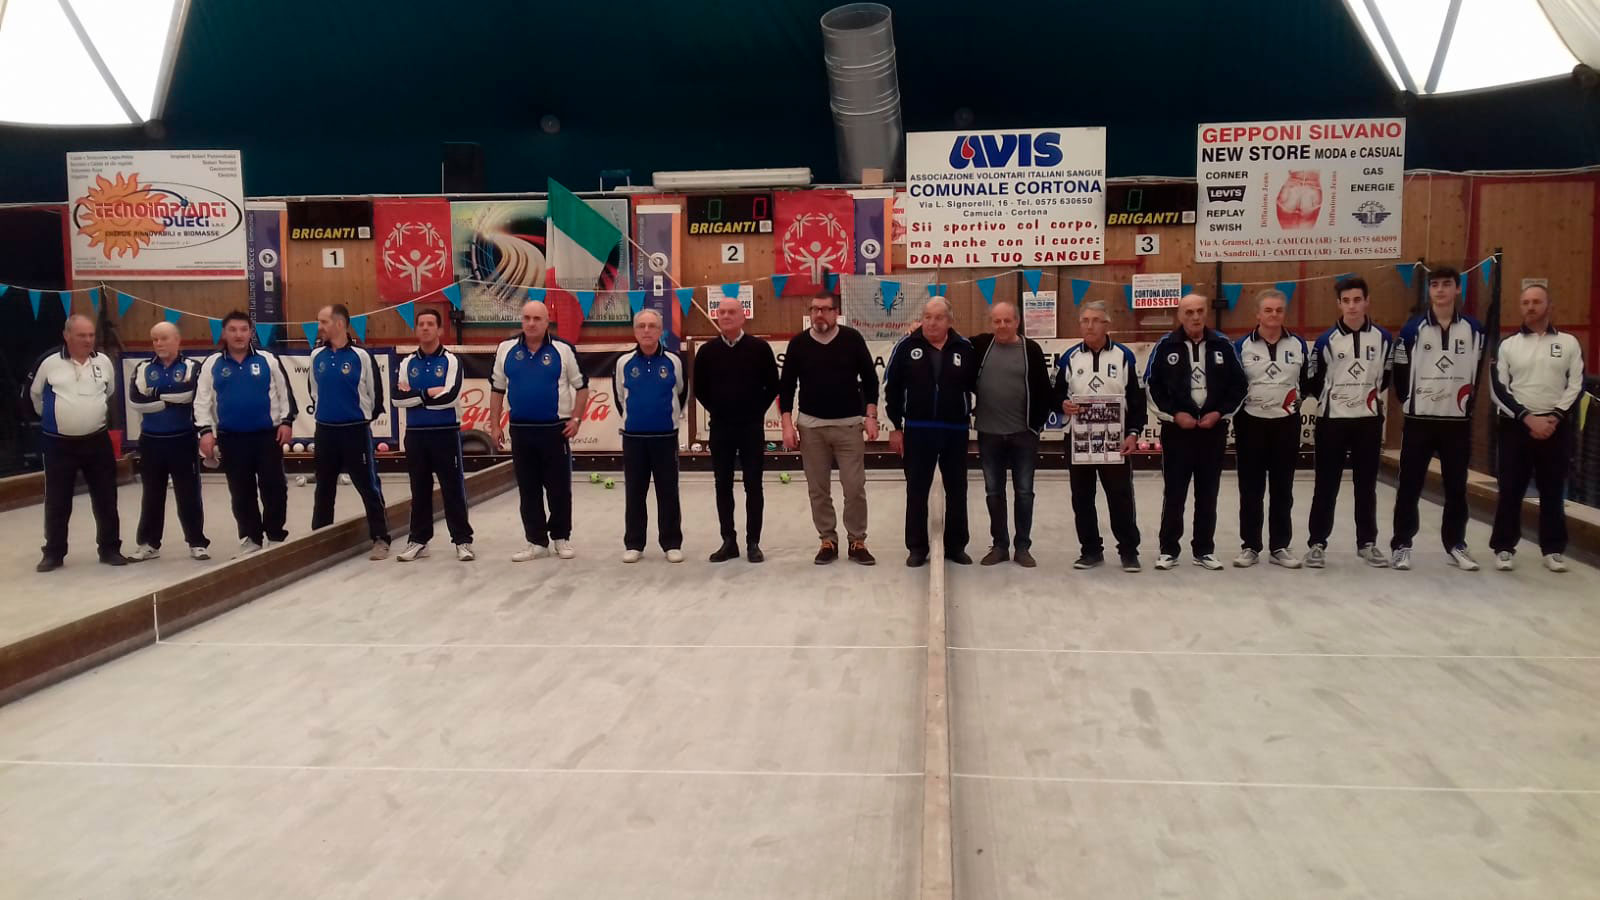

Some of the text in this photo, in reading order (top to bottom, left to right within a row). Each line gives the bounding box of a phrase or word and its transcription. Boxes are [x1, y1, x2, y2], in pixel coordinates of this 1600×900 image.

[1202, 122, 1402, 143] GEPPONI SILVANO
[949, 132, 1063, 169] AVIS
[1202, 145, 1402, 162] NEW STORE MODA e CASUAL
[910, 169, 1103, 181] ASSOCIAZIONE VOLONTARI ITALIANI SANGUE
[1206, 171, 1248, 180] CORNER
[1363, 168, 1384, 176] GAS
[910, 180, 1102, 197] COMUNALE CORTONA
[1351, 183, 1395, 192] ENERGIE
[947, 200, 995, 209] Signorelli,
[1035, 198, 1057, 206] 0575
[1060, 197, 1093, 205] 630650
[1011, 209, 1048, 217] Cortona
[1108, 212, 1179, 225] BRIGANTI
[1206, 209, 1245, 218] REPLAY
[690, 221, 757, 234] BRIGANTI
[912, 219, 1098, 234] Sii sportivo col corpo,
[1209, 224, 1242, 232] SWISH
[292, 228, 355, 240] BRIGANTI
[910, 235, 1100, 249] ma anche con il cuore:
[1141, 236, 1153, 252] 3
[1222, 238, 1254, 246] Gramsci,
[1277, 237, 1314, 245] CAMUCIA
[1315, 236, 1332, 245] (AR)
[1339, 236, 1352, 244] Tel.
[1353, 235, 1370, 243] 0575
[727, 246, 739, 261] 2
[910, 251, 1101, 264] DONA IL TUO SANGUE
[1223, 249, 1260, 257] Sandrelli,
[1273, 248, 1312, 256] CAMUCIA
[1314, 248, 1332, 256] (AR)
[1339, 247, 1352, 255] Tel.
[1374, 246, 1397, 254] 62655
[248, 248, 256, 271] Bocce
[329, 251, 338, 265] 1
[1135, 288, 1180, 298] CORTONA BOCCE
[1135, 298, 1179, 306] GROSSETO
